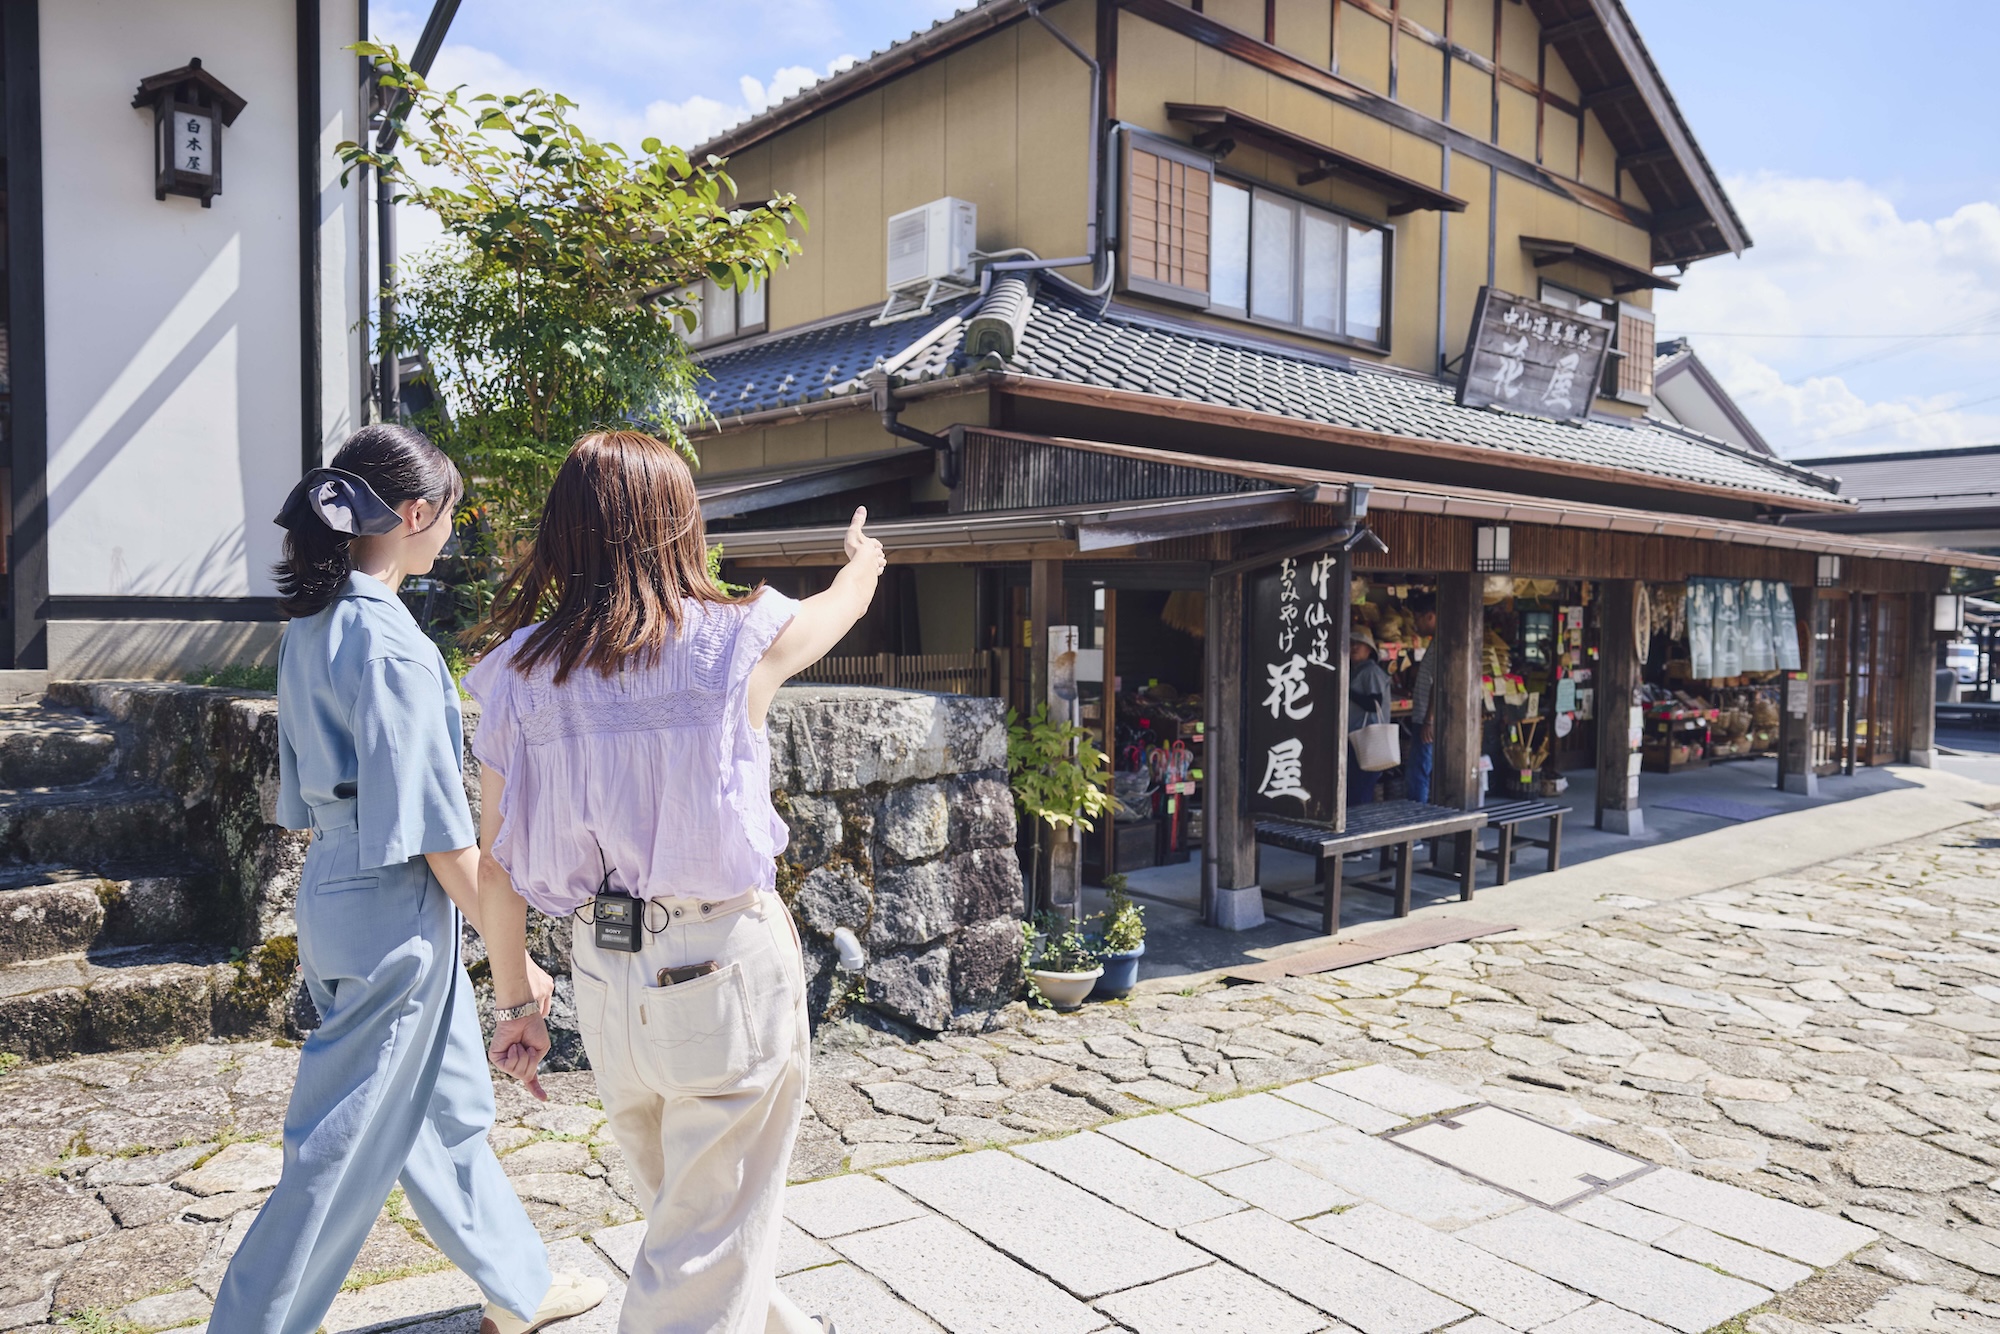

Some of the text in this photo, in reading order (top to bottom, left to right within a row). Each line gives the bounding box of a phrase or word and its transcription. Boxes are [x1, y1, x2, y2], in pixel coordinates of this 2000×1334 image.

[186, 119, 202, 170] 白木屋
[1492, 336, 1580, 409] 花屋
[1278, 557, 1301, 654] おみやげ
[1304, 552, 1337, 671] 中仙道
[1257, 653, 1314, 802] 花屋
